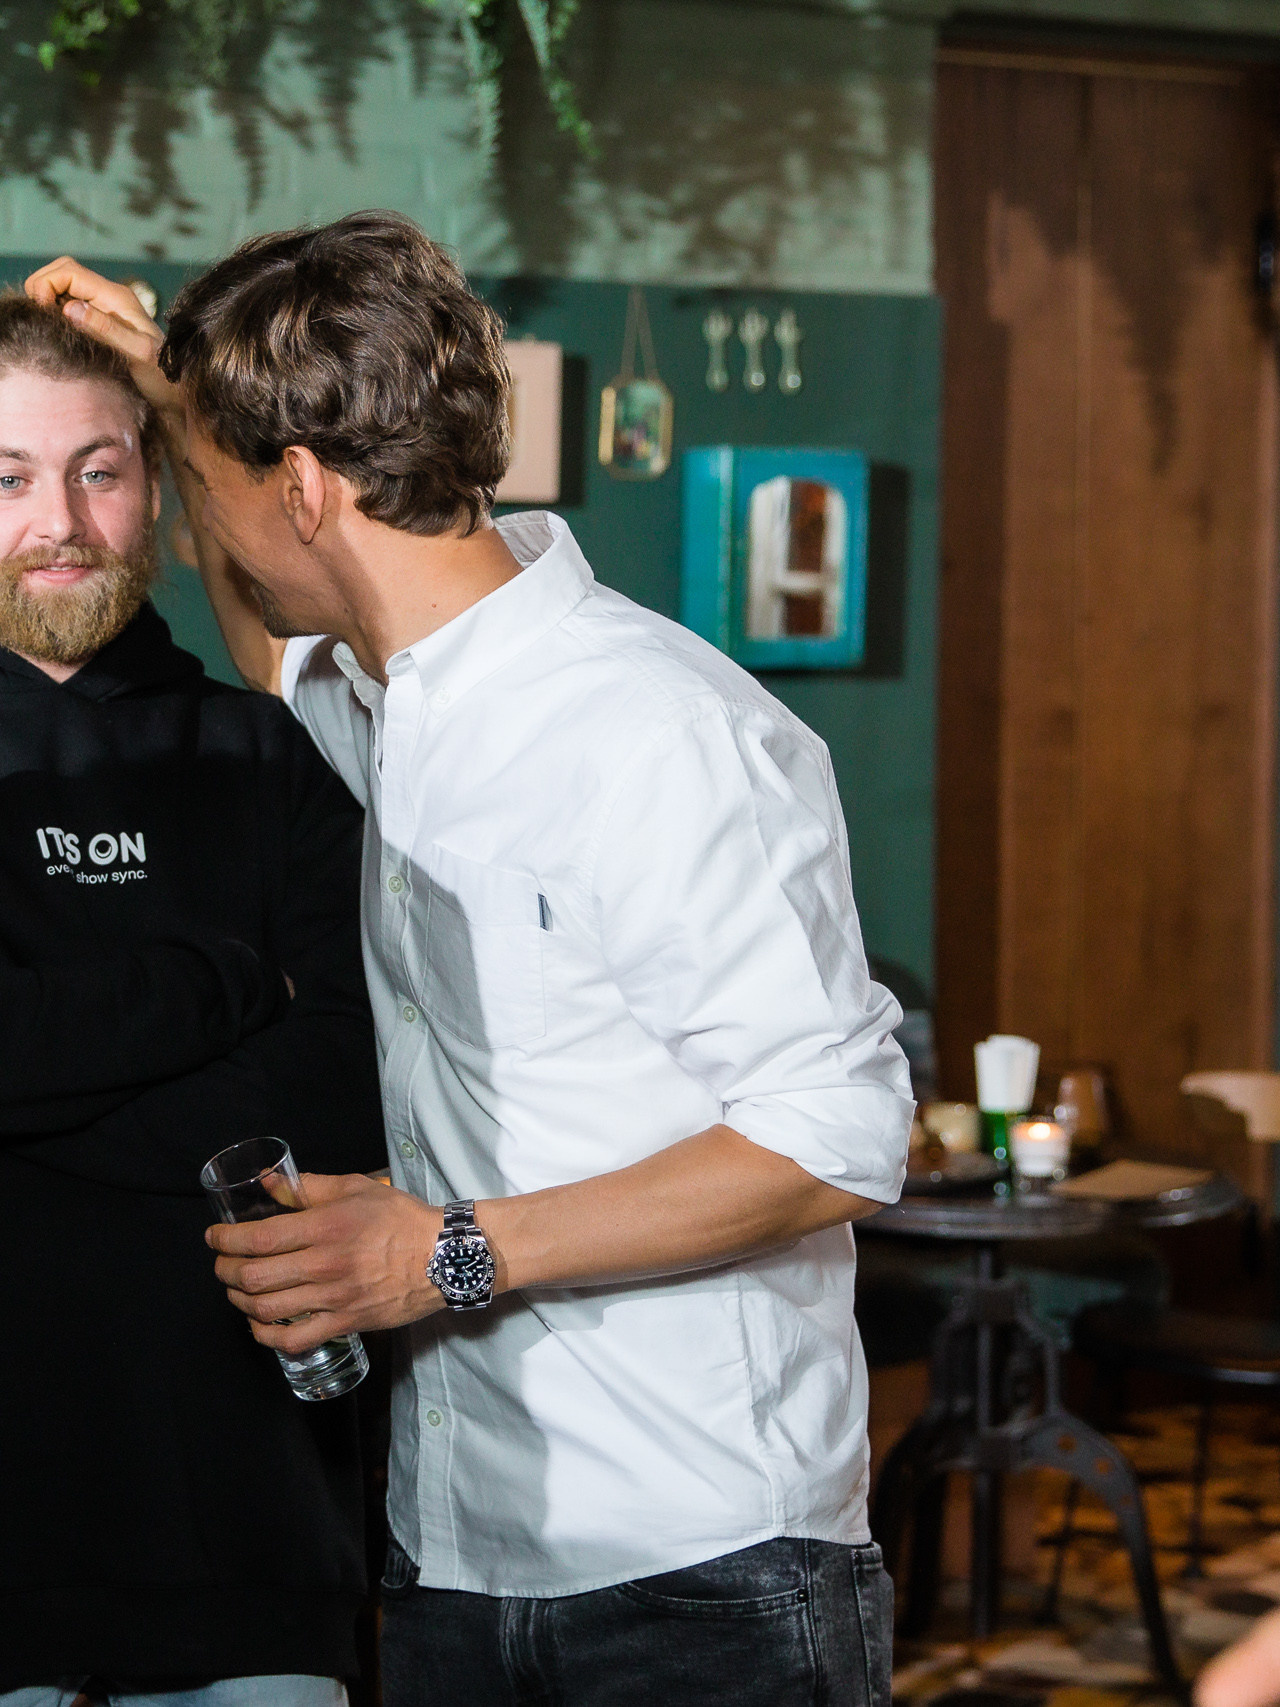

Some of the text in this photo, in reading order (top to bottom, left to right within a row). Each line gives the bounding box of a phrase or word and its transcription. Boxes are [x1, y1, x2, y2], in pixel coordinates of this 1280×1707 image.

[36, 827, 146, 865] ITS ON
[76, 871, 108, 884] show
[111, 869, 148, 884] sync.
